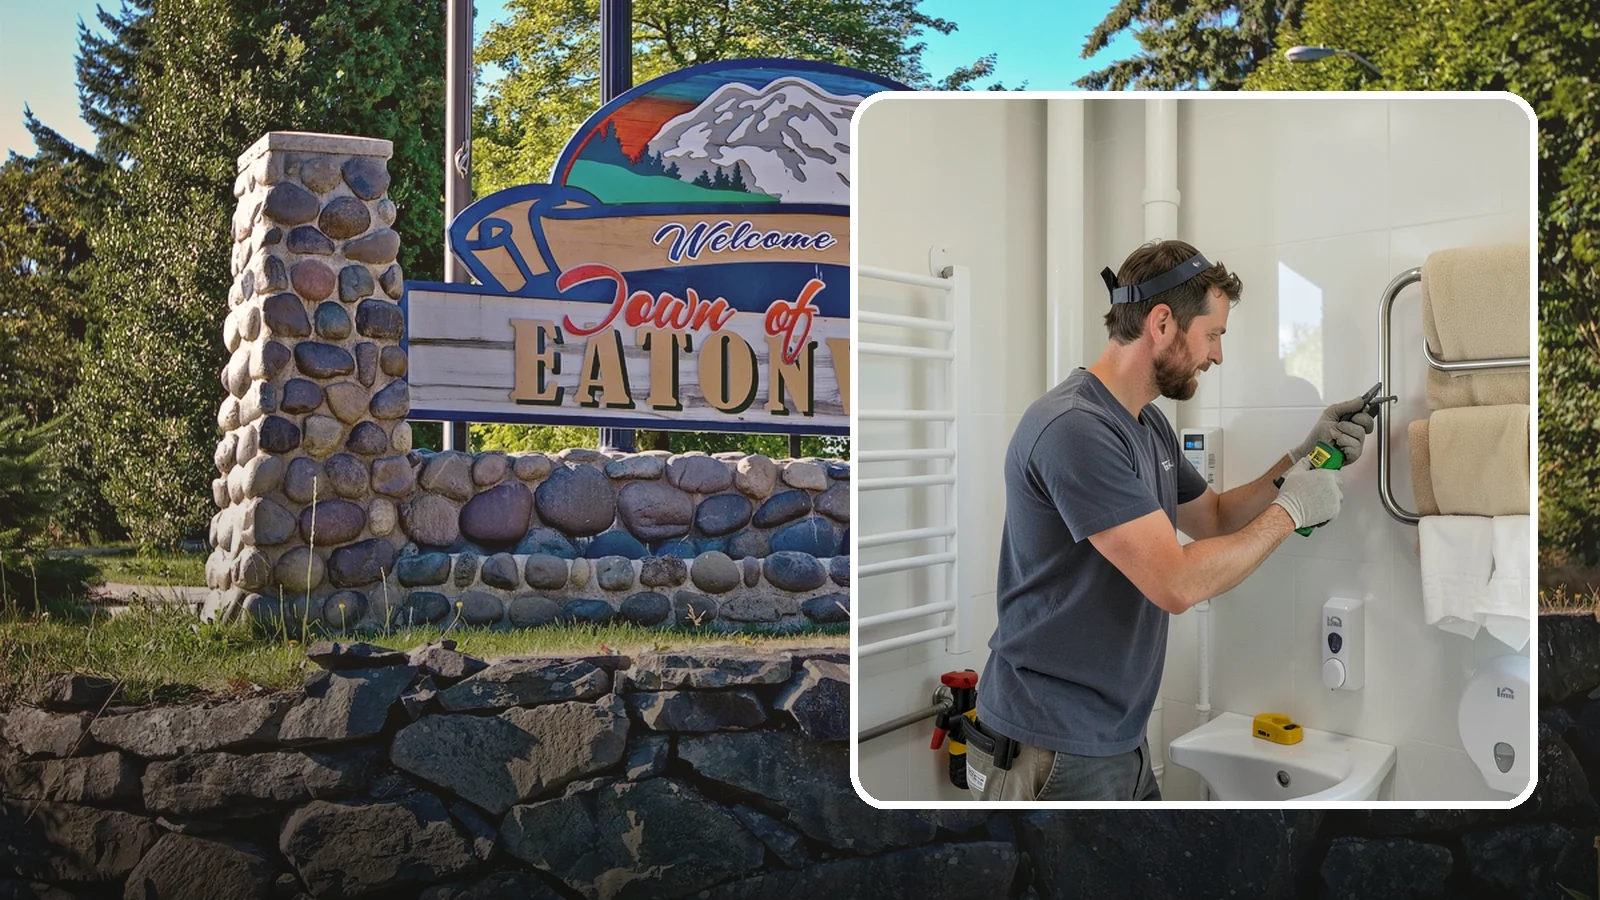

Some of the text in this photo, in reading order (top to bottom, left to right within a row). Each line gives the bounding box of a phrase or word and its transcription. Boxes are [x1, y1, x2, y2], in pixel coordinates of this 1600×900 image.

[653, 219, 837, 263] Welcome
[557, 263, 826, 365] Town of
